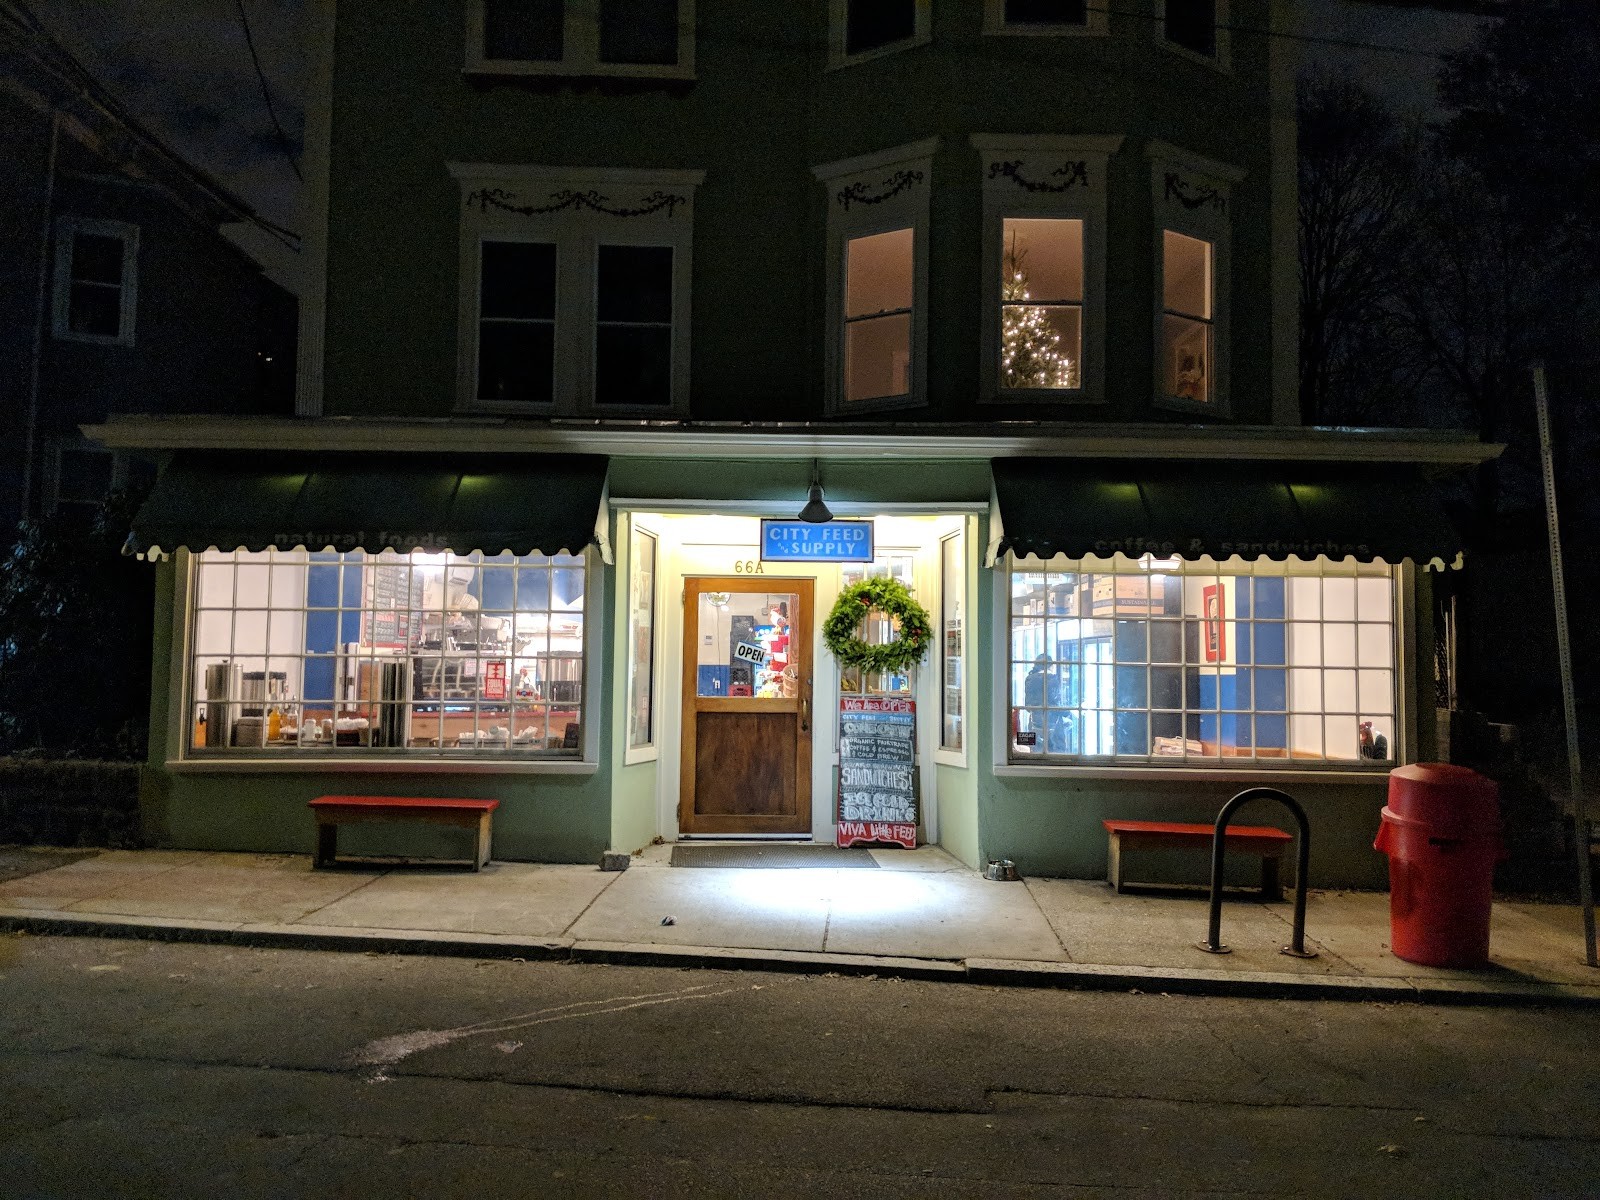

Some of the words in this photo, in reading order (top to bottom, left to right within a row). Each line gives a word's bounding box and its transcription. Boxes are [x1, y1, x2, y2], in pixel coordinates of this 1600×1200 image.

[274, 531, 365, 546] natural
[378, 531, 448, 547] foods
[769, 528, 811, 540] CITY
[822, 528, 865, 541] FEED
[791, 542, 857, 554] SUPPLY
[1095, 536, 1175, 550] coffee
[1221, 539, 1371, 554] sandwiches
[734, 560, 765, 574] 66A
[738, 645, 765, 662] OPEN
[844, 699, 862, 711] We
[863, 699, 880, 711] Are
[849, 737, 875, 745] ORGANIC
[849, 744, 871, 752] COFFEE
[878, 746, 910, 756] ESPRESSO
[840, 822, 867, 836] VIVA
[893, 825, 916, 841] FEED
